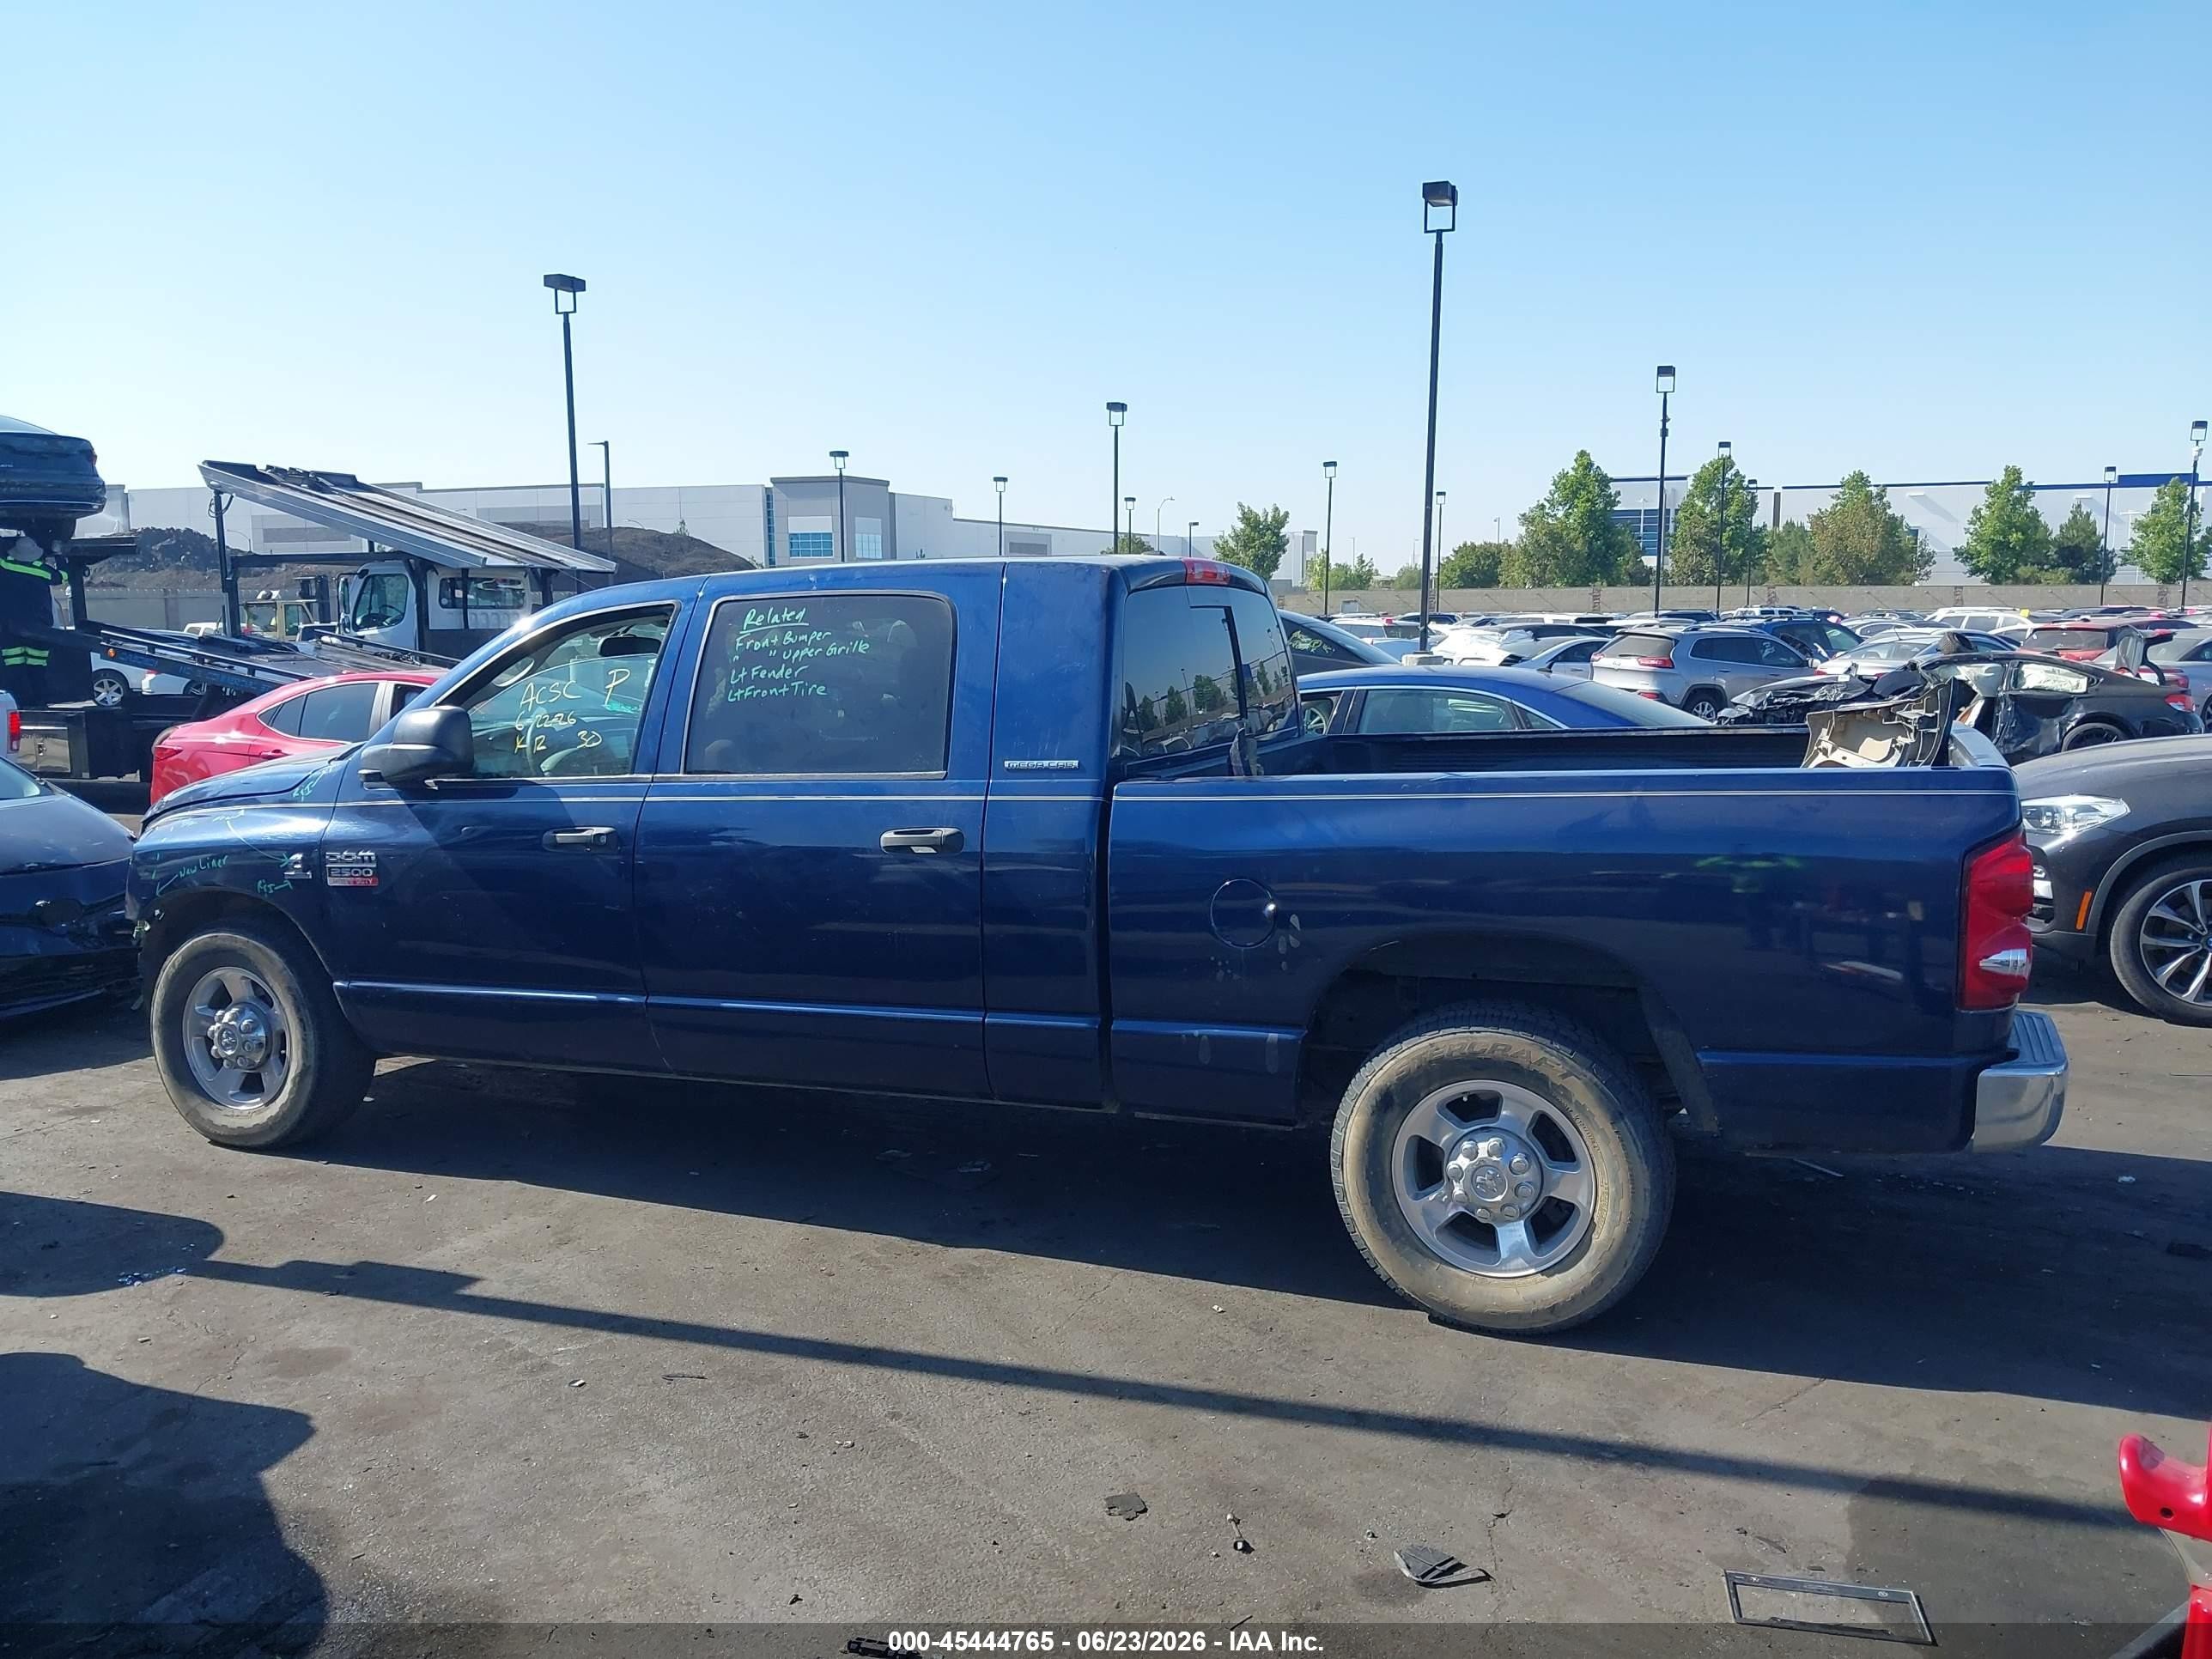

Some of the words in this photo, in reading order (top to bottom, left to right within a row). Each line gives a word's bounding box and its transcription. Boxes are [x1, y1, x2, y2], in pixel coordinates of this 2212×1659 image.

[744, 607, 806, 630] Related
[736, 633, 778, 651] Front
[783, 631, 831, 647] Bumper
[751, 664, 809, 680] Fender
[520, 680, 582, 712] ACSC
[605, 669, 630, 706] P
[791, 681, 827, 697] Tire
[330, 868, 374, 877] 2500
